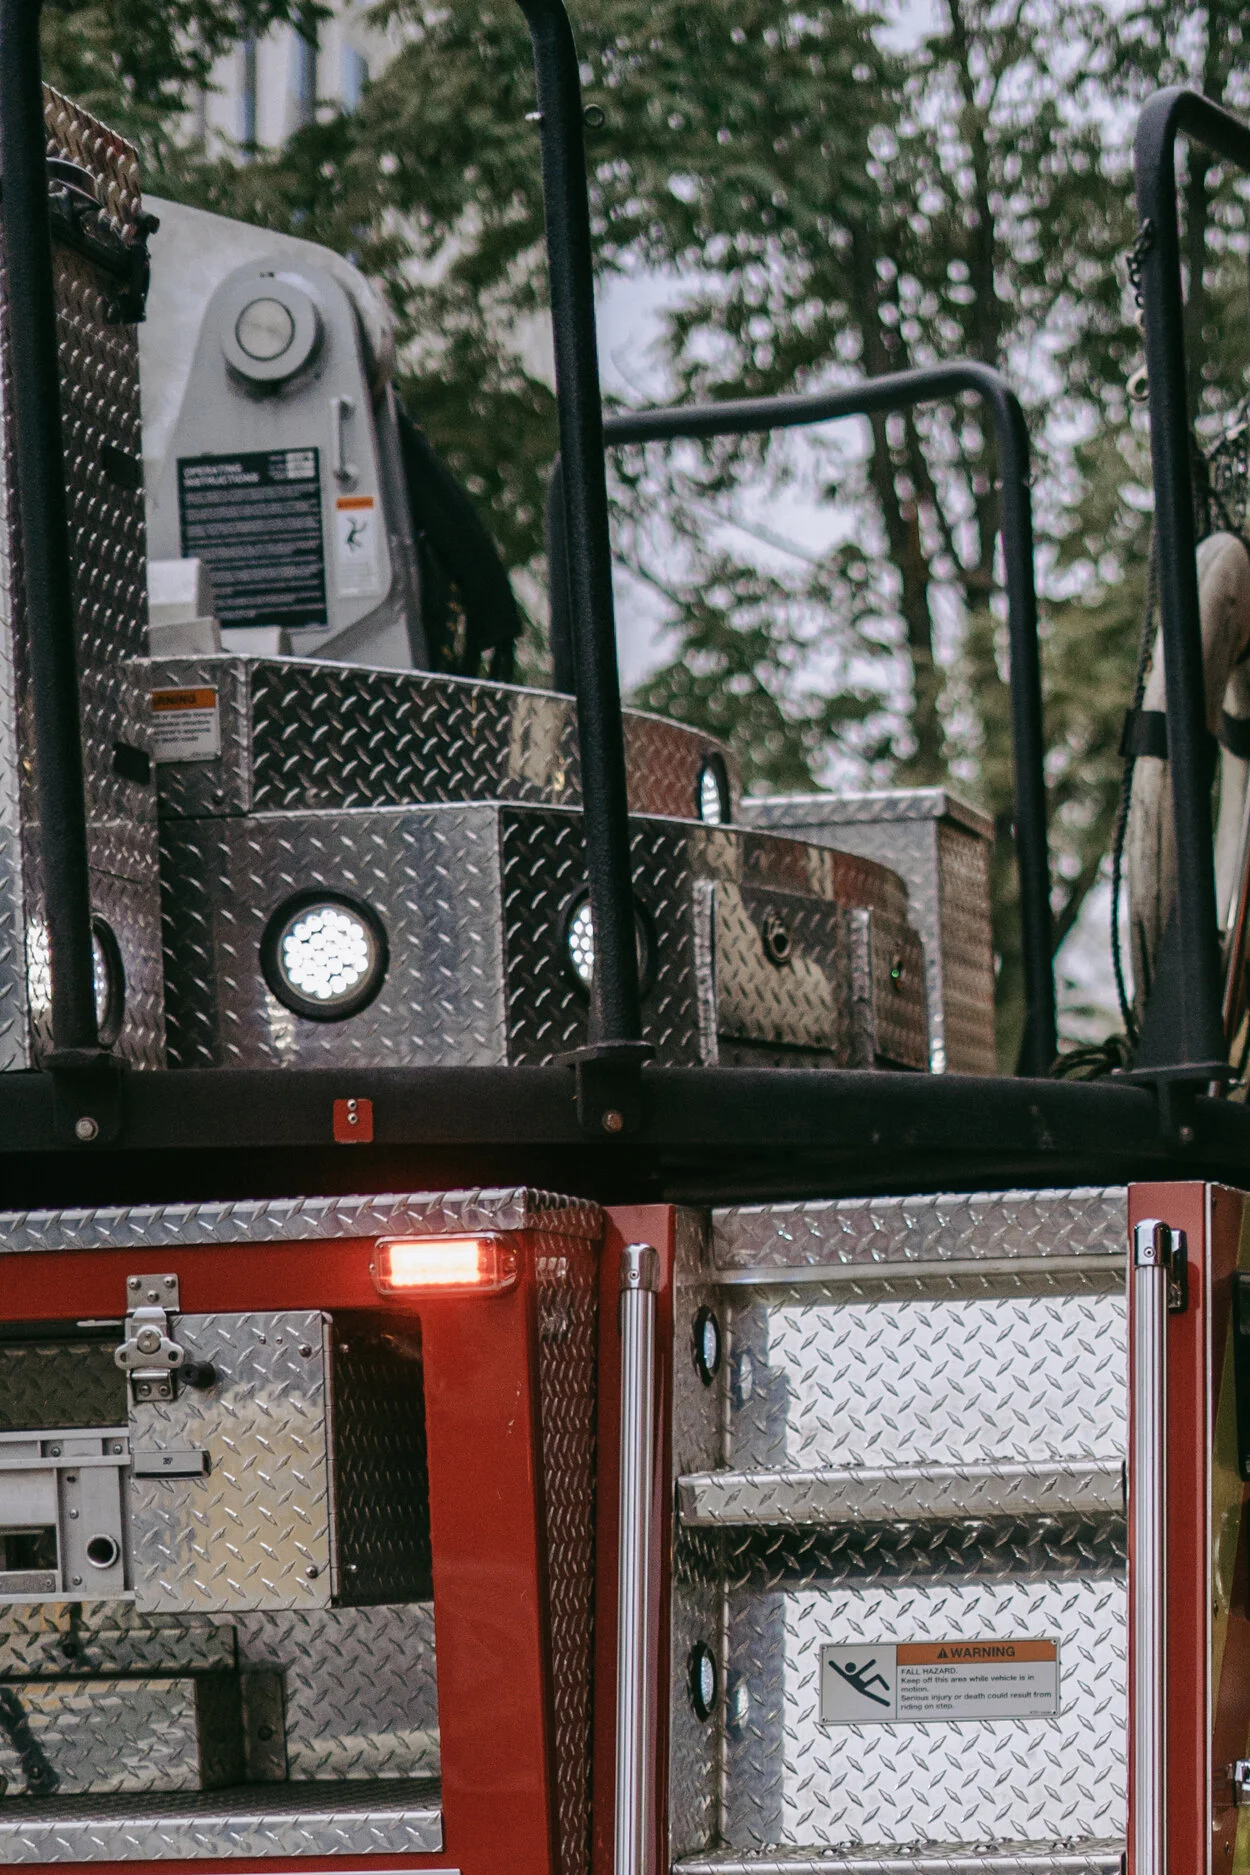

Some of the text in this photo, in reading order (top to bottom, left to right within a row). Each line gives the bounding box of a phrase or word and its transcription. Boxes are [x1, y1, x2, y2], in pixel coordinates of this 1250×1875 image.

[950, 1646, 1016, 1659] WARNING
[901, 1667, 958, 1676] FALL HAZARD.
[901, 1677, 921, 1685] Keep
[922, 1676, 933, 1684] off
[900, 1694, 930, 1702] Serious
[931, 1694, 952, 1702] injury
[900, 1703, 923, 1711] riding
